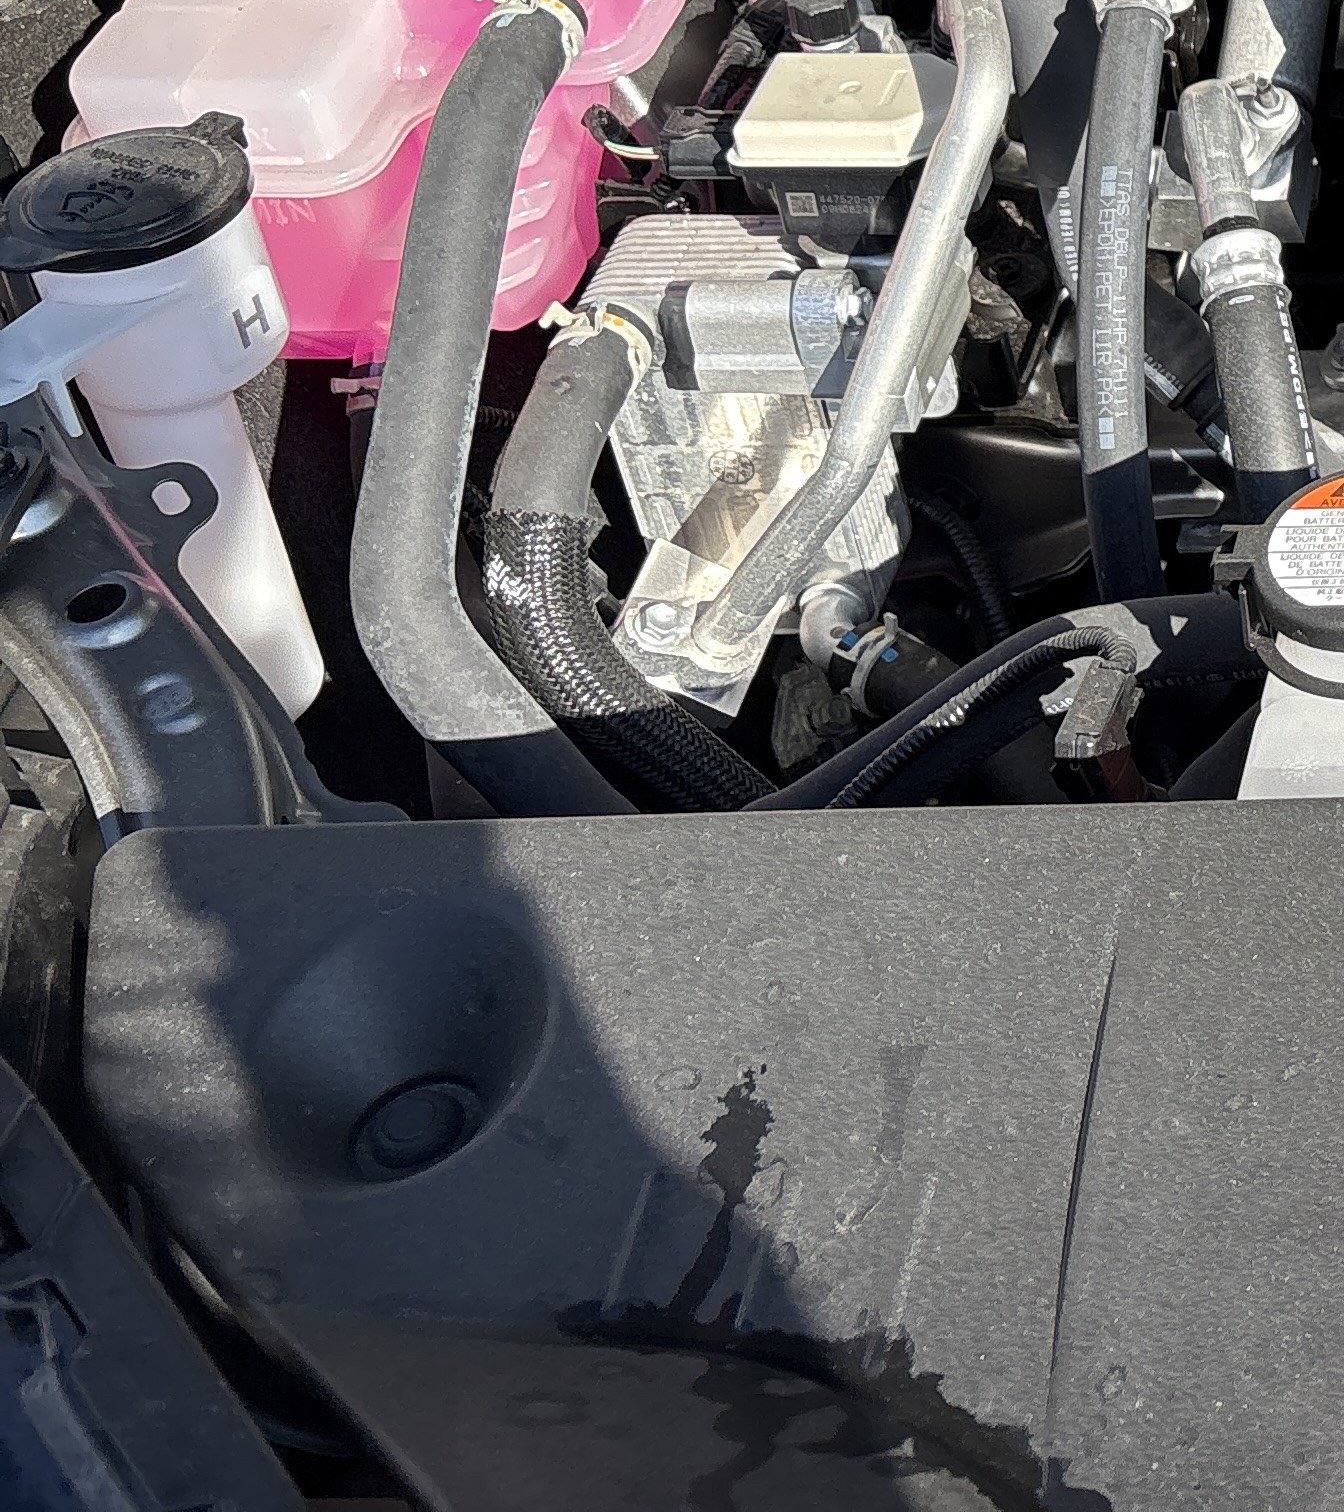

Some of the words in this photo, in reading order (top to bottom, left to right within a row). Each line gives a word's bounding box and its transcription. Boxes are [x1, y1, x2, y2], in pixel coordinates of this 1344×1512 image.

[232, 294, 271, 350] H
[1285, 535, 1317, 543] POUR
[1280, 553, 1324, 561] LIQUIDE
[1330, 552, 1344, 560] DE
[1288, 561, 1304, 569] DE
